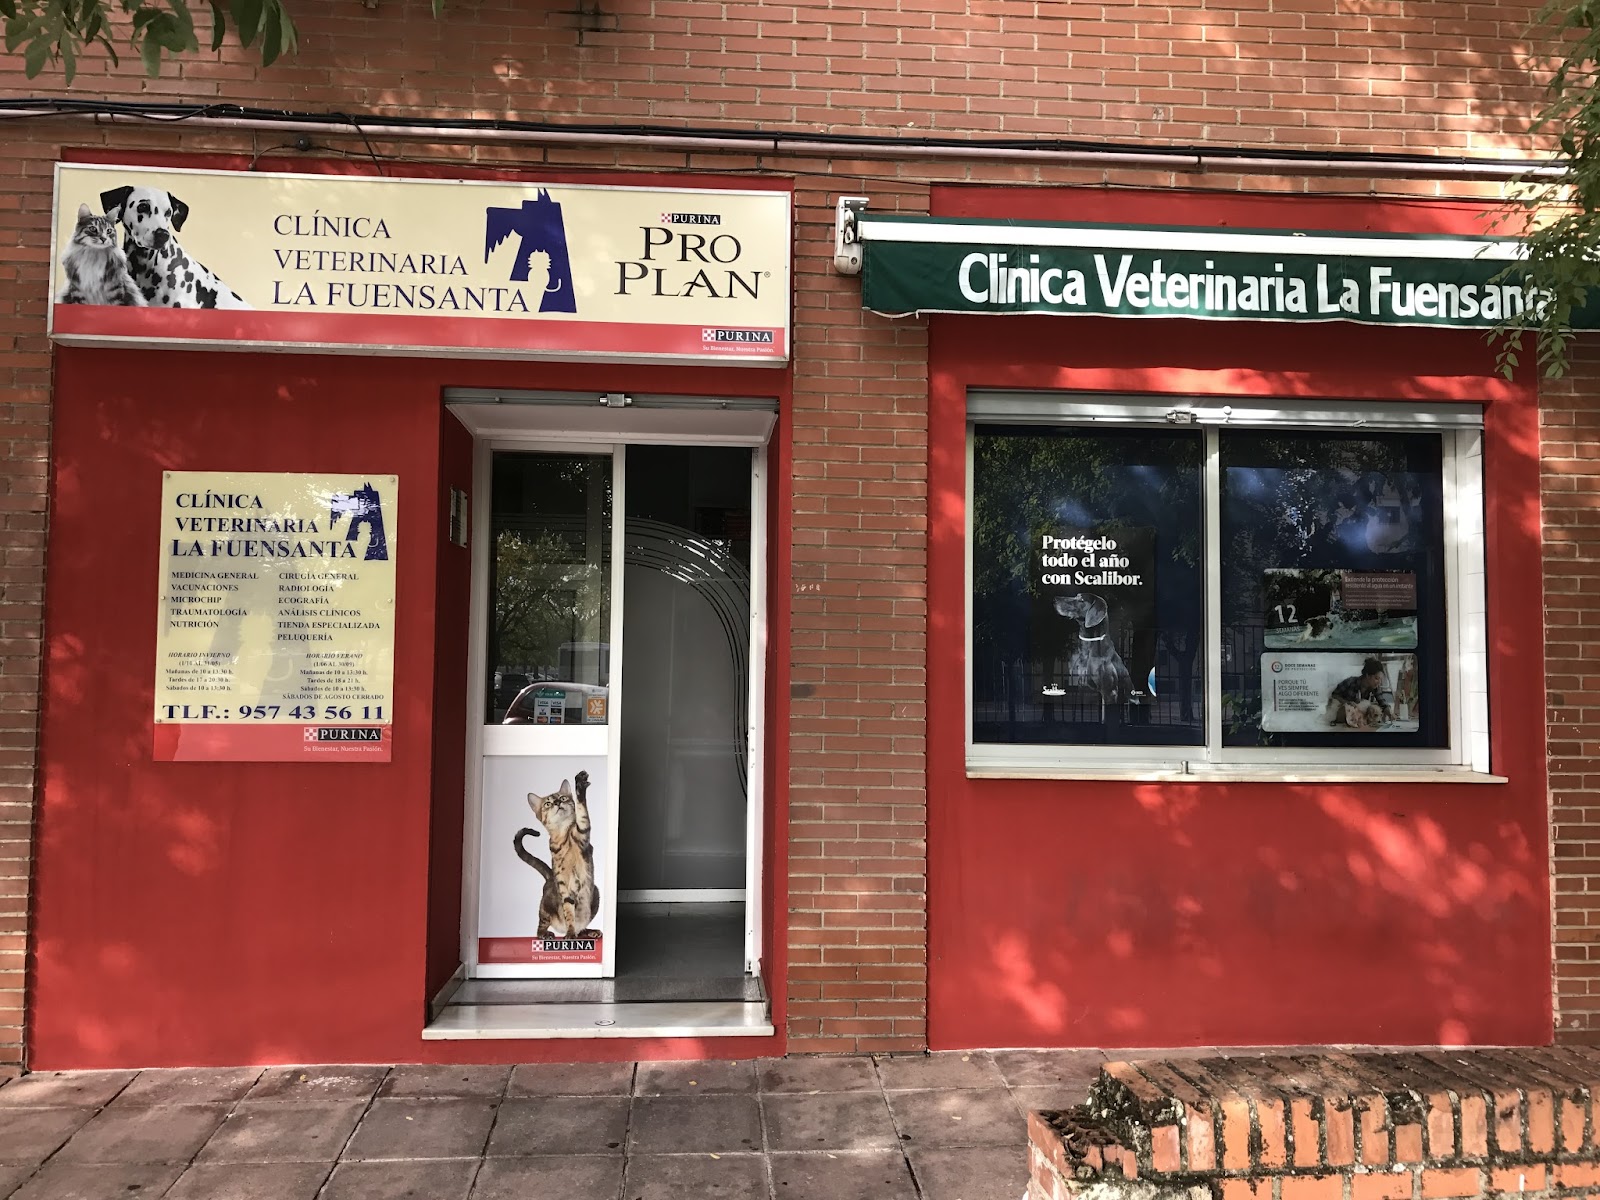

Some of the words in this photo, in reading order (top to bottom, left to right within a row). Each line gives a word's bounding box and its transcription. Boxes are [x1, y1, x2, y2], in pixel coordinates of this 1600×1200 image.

[273, 210, 391, 239] CLÍNICA
[673, 214, 719, 224] PURINA
[639, 227, 741, 263] PRO
[273, 248, 468, 276] VETERINARIA
[958, 252, 1087, 306] Clinica
[1092, 254, 1307, 314] Veterinaria
[1317, 263, 1360, 313] La
[271, 280, 317, 306] LA
[326, 283, 531, 313] FUENSANTA
[717, 331, 771, 342] PURINA
[176, 490, 263, 509] CLÍNICA
[175, 517, 319, 533] VETERINARIA
[171, 539, 205, 557] LA
[210, 539, 356, 558] FUENSANTA
[1042, 535, 1117, 553] Protégelo
[1042, 553, 1078, 568] todo
[1081, 553, 1095, 568] el
[1099, 554, 1129, 568] año
[172, 571, 216, 579] MEDICINA
[217, 572, 259, 580] GENERAL
[279, 572, 316, 580] CIRUGÍA
[1042, 573, 1072, 585] con
[1074, 571, 1143, 586] Scalibor.
[171, 584, 239, 592] VACUNACIONES
[279, 584, 334, 592] RADIOLOGÍA
[278, 596, 329, 604] ECOGRAFÍA
[170, 607, 248, 616] TRAUMATOLOGÍA
[278, 608, 318, 616] ANÁLISIS
[319, 608, 361, 617] CLÍNICOS
[1274, 604, 1298, 624] 12
[170, 619, 219, 628] NUTRICIÓN
[277, 621, 310, 629] TIENDA
[1276, 626, 1300, 634] SEMANAS
[277, 633, 333, 642] PELUQUERÍA
[162, 705, 230, 719] TLF.:
[238, 705, 281, 720] 957
[288, 705, 316, 719] 43
[324, 705, 352, 719] 56
[361, 706, 384, 719] 11
[320, 729, 379, 740] PURINA
[545, 941, 593, 950] PURINA
